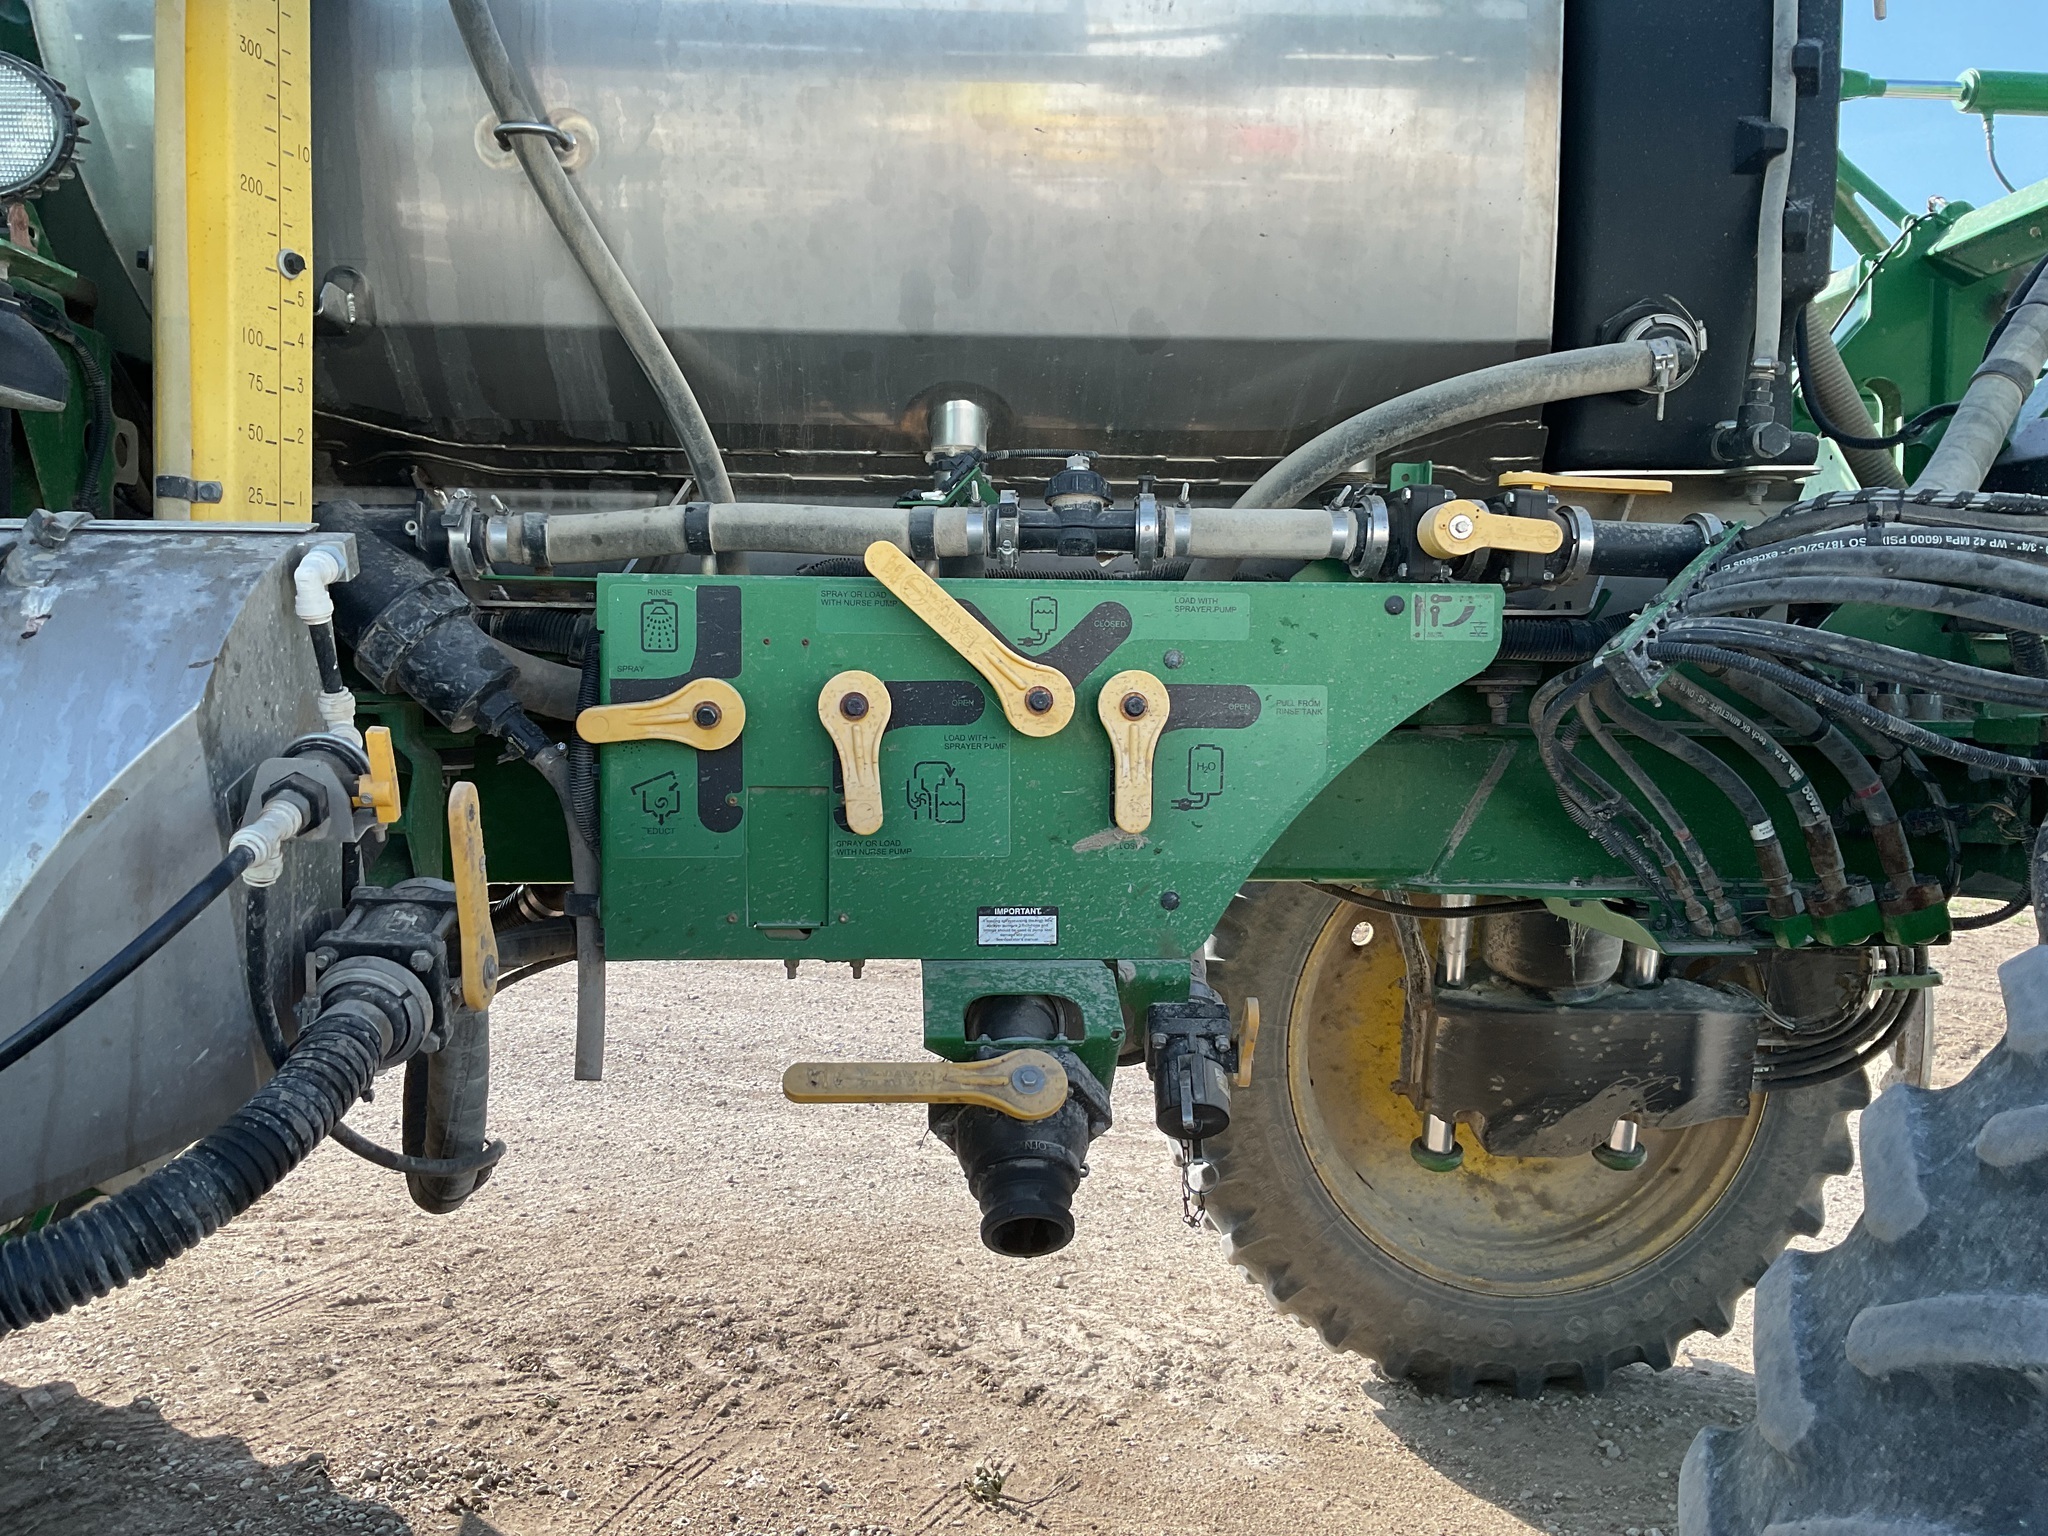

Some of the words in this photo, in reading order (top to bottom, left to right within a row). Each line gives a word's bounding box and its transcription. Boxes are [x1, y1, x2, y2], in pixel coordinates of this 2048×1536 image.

[239, 34, 262, 60] 300
[298, 144, 310, 163] 10
[240, 173, 263, 196] 200
[297, 291, 305, 308] 5
[242, 326, 263, 347] 100
[297, 332, 305, 349] 4
[248, 372, 264, 392] 75
[297, 377, 304, 394] 3
[248, 423, 264, 442] 50
[297, 427, 304, 445] 2
[248, 486, 264, 505] 25
[1882, 535, 1906, 545] PSI)
[1910, 535, 1943, 545] (6000
[1946, 535, 1970, 546] MPa
[1973, 536, 1986, 547] 42
[1990, 538, 2007, 549] WP
[2017, 541, 2037, 552] 3/4"
[820, 590, 848, 598] SPRAY
[850, 590, 863, 598] OR
[864, 591, 887, 599] LOAD
[820, 598, 842, 606] WITH
[843, 599, 872, 607] NURSE
[1174, 597, 1196, 605] LOAD
[1197, 597, 1219, 605] WITH
[1174, 605, 1213, 613] SPRAYER
[1093, 620, 1127, 628] CLOSED
[617, 665, 645, 673] SPRAY
[951, 699, 975, 707] OPEN
[1228, 703, 1250, 711] OPEN
[1275, 699, 1295, 707] PULL
[1297, 699, 1321, 707] FROM
[1302, 708, 1323, 716] TANK
[943, 734, 966, 742] LOAD
[967, 734, 988, 742] WITH
[944, 742, 982, 750] SPRAYER
[984, 742, 1007, 750] PUMP
[646, 827, 676, 835] EDUCT
[836, 840, 863, 848] SPRAY
[879, 839, 902, 847] LOAD
[836, 848, 857, 856] WITH
[858, 848, 887, 856] NURSE
[889, 847, 912, 855] PUMP
[994, 907, 1042, 915] IMPORTANT
